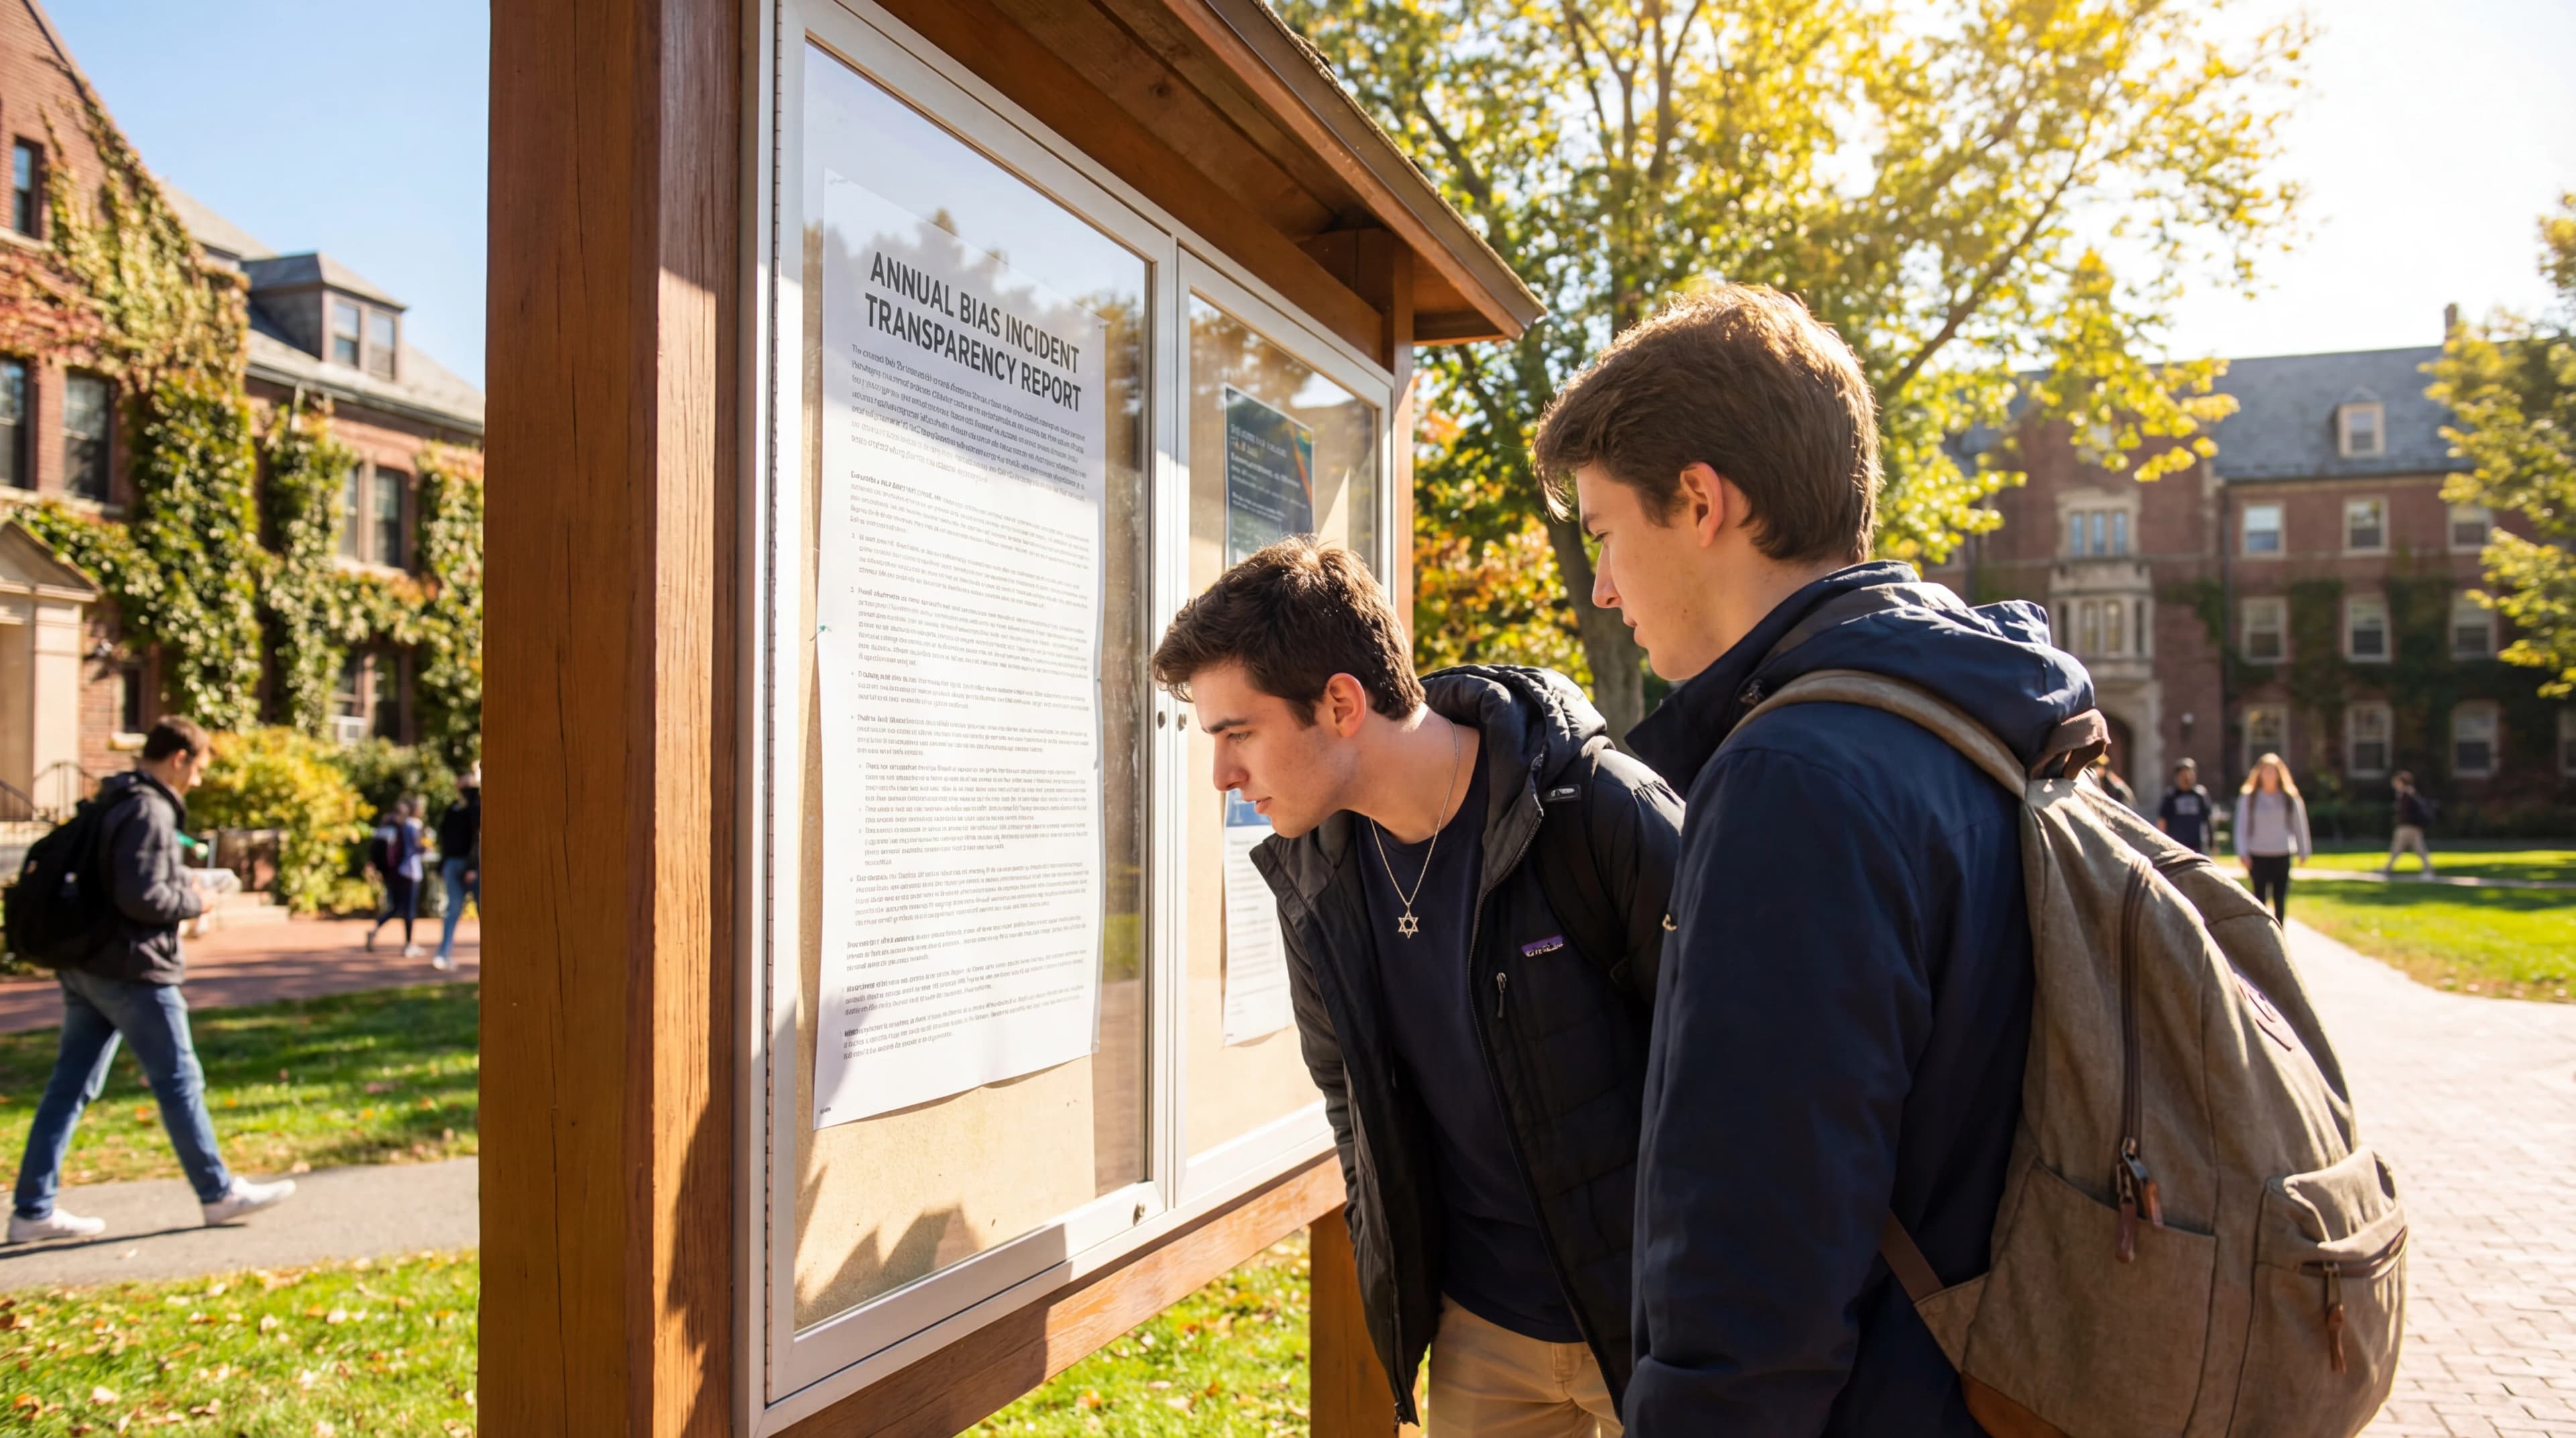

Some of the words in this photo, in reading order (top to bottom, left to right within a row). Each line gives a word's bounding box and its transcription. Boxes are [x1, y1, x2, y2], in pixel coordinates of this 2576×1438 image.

[865, 293, 1016, 384] TRANSPARENCY
[1021, 362, 1081, 411] REPORT
[870, 252, 954, 317] ANNUAL
[960, 292, 1000, 337] BIAS
[1006, 314, 1079, 373] INCIDENT
